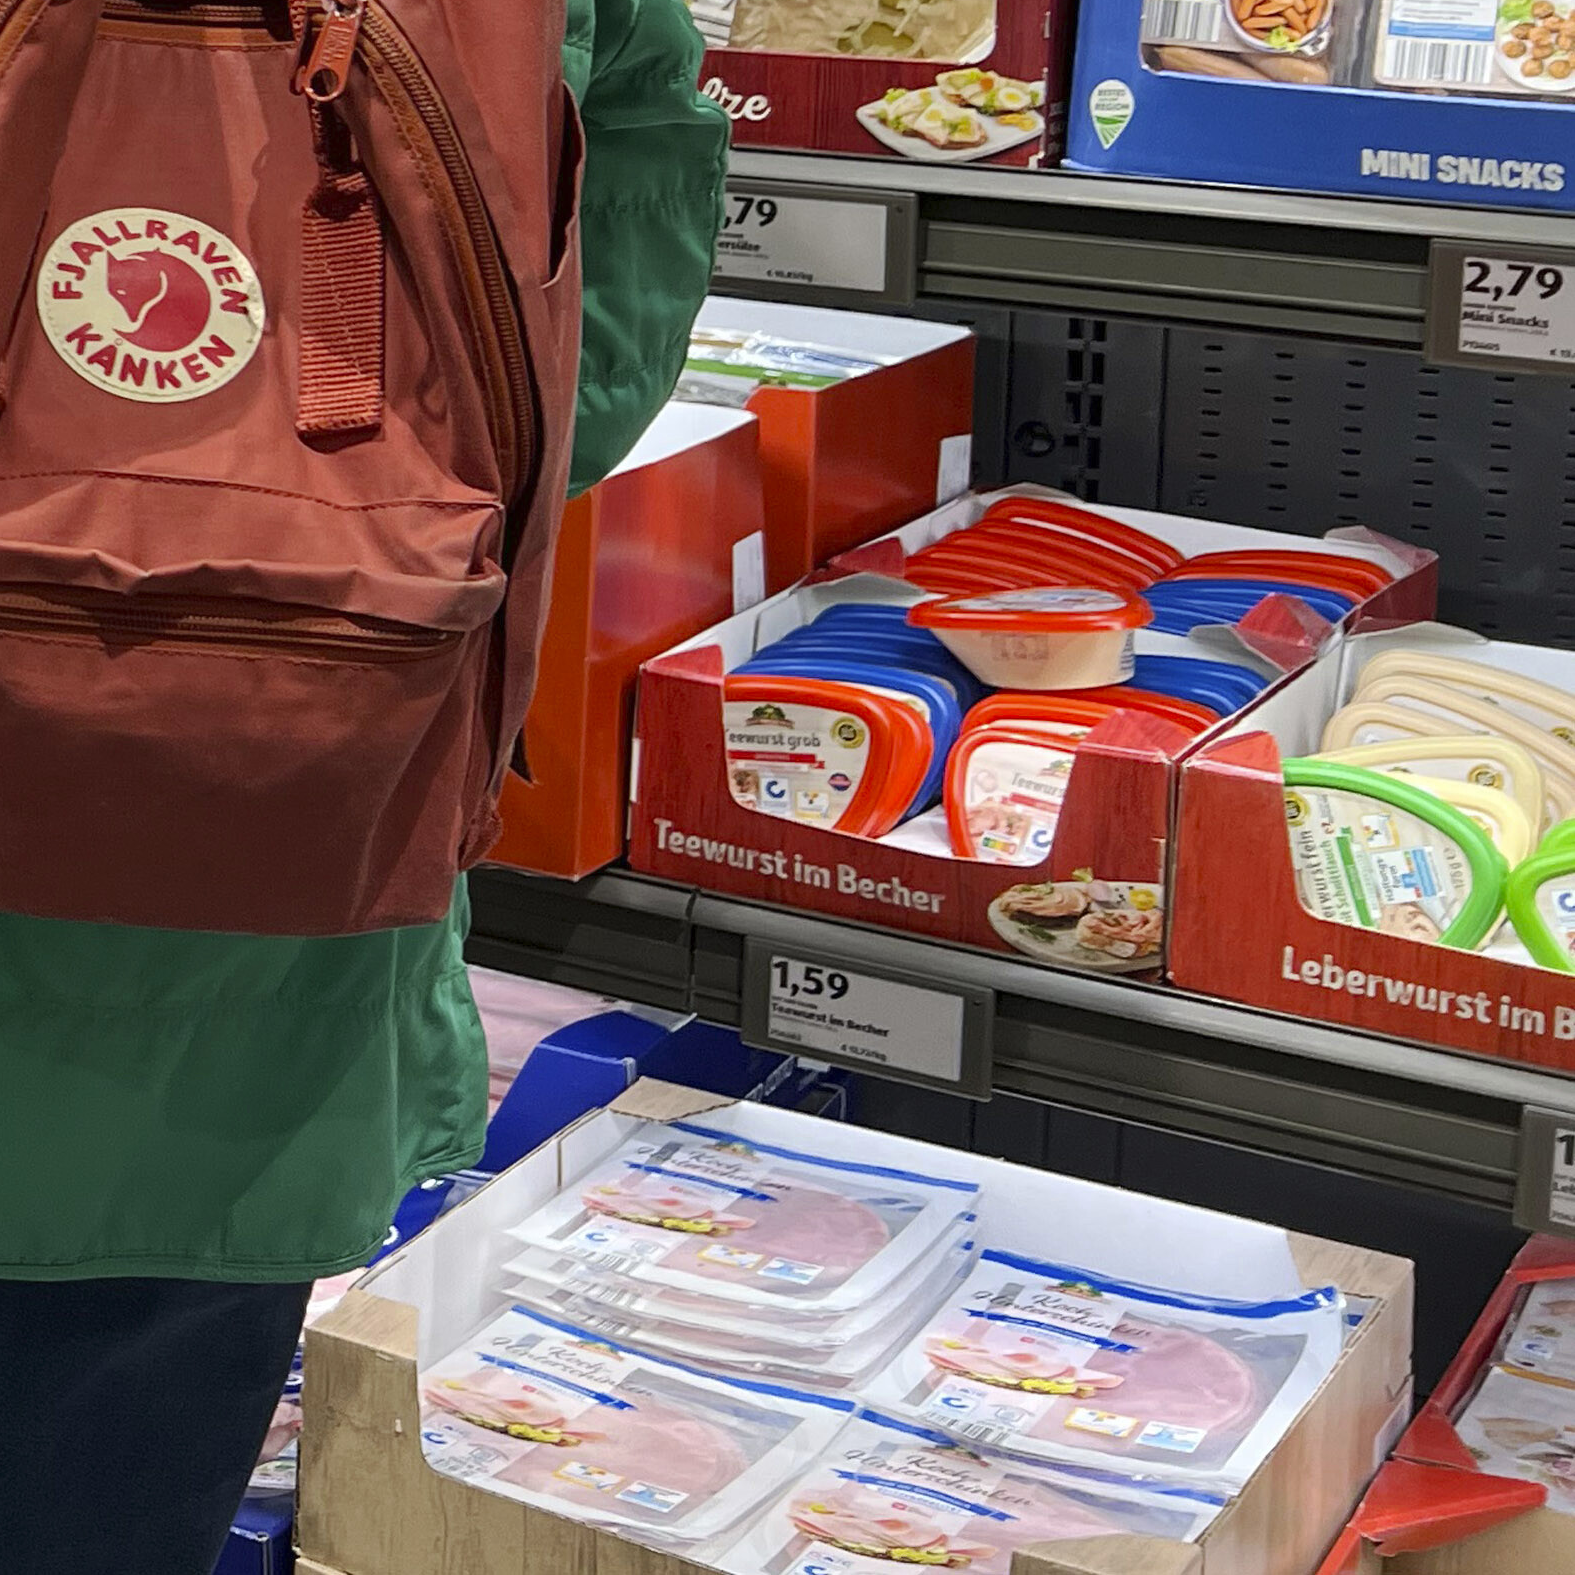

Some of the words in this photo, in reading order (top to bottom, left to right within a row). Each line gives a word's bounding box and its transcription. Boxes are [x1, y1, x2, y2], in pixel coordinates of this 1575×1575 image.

[1360, 147, 1430, 182] MINI
[1436, 154, 1566, 192] SNACKS
[1464, 260, 1563, 302] 2,79
[1462, 310, 1495, 324] Mini
[1497, 313, 1550, 329] Snacks
[726, 730, 785, 746] eewurst
[787, 732, 821, 751] grob
[654, 818, 791, 885] Teewurst
[793, 858, 830, 890] im
[836, 862, 946, 915] Becher
[773, 959, 849, 1000] 1,59
[1281, 945, 1493, 1024] Leberwurst
[1500, 995, 1547, 1036] im
[772, 1003, 826, 1024] Teewurst
[828, 1014, 844, 1027] im
[846, 1018, 889, 1039] Becher
